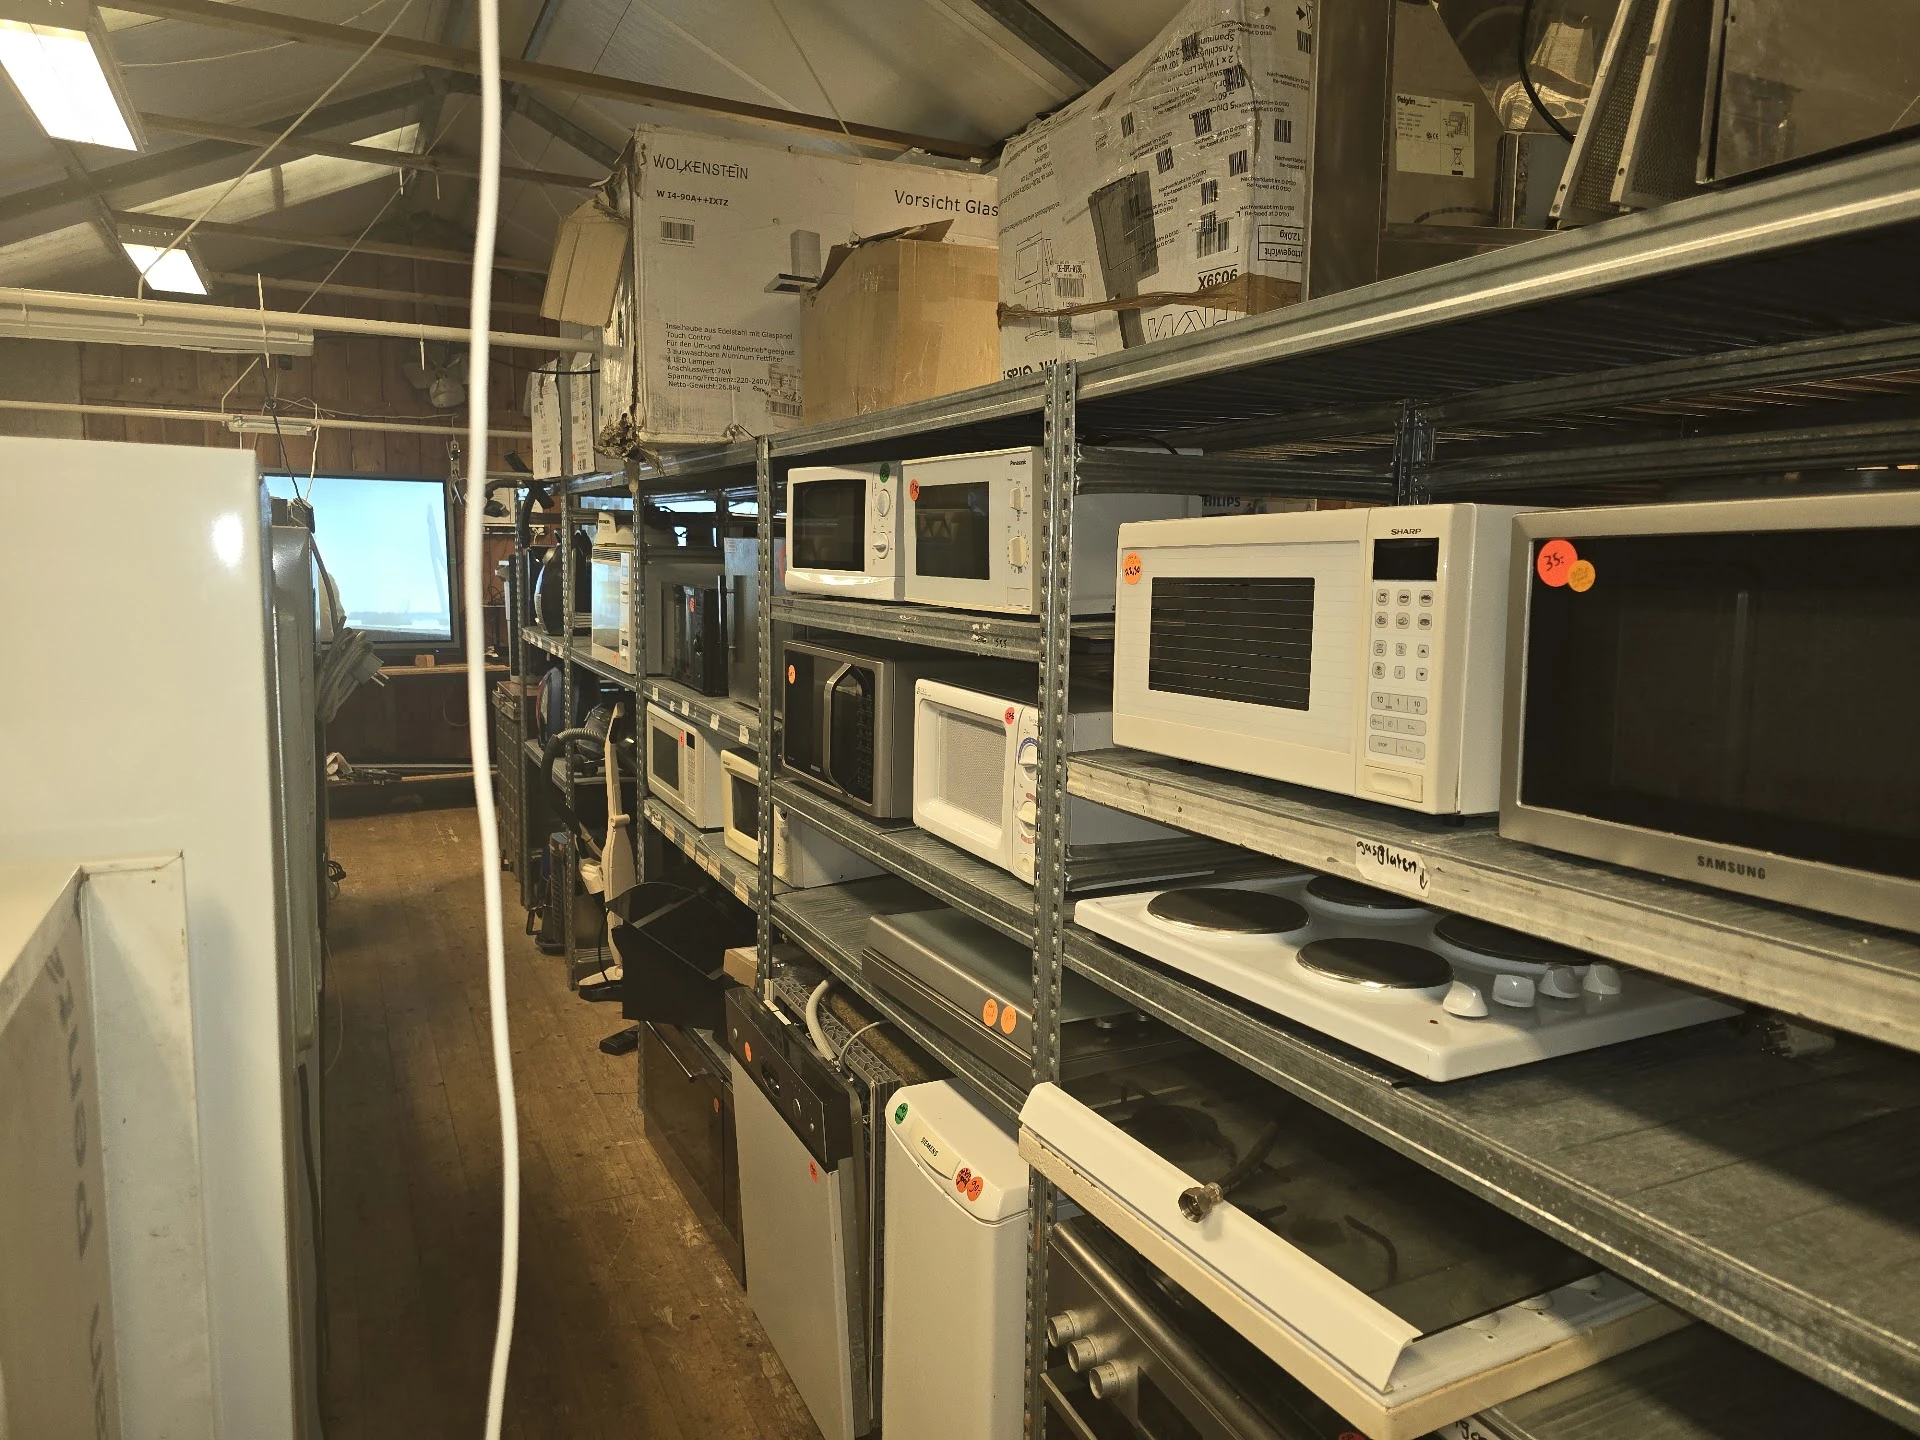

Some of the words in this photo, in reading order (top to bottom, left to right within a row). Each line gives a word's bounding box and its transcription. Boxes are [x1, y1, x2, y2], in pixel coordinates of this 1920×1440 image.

[653, 154, 748, 179] WOLKENSTEIN
[895, 190, 960, 211] Vorsicht
[665, 323, 702, 332] Inselhaube
[718, 327, 748, 336] Edelstahl
[762, 331, 793, 341] Glaspanel
[667, 331, 686, 339] Touch
[688, 333, 712, 341] Control
[672, 349, 720, 359] auswaschbare
[688, 357, 715, 366] Lampen
[1202, 496, 1240, 507] HILIPS
[1697, 856, 1766, 879] SAMSUNG
[921, 1137, 938, 1156] SIEMENS
